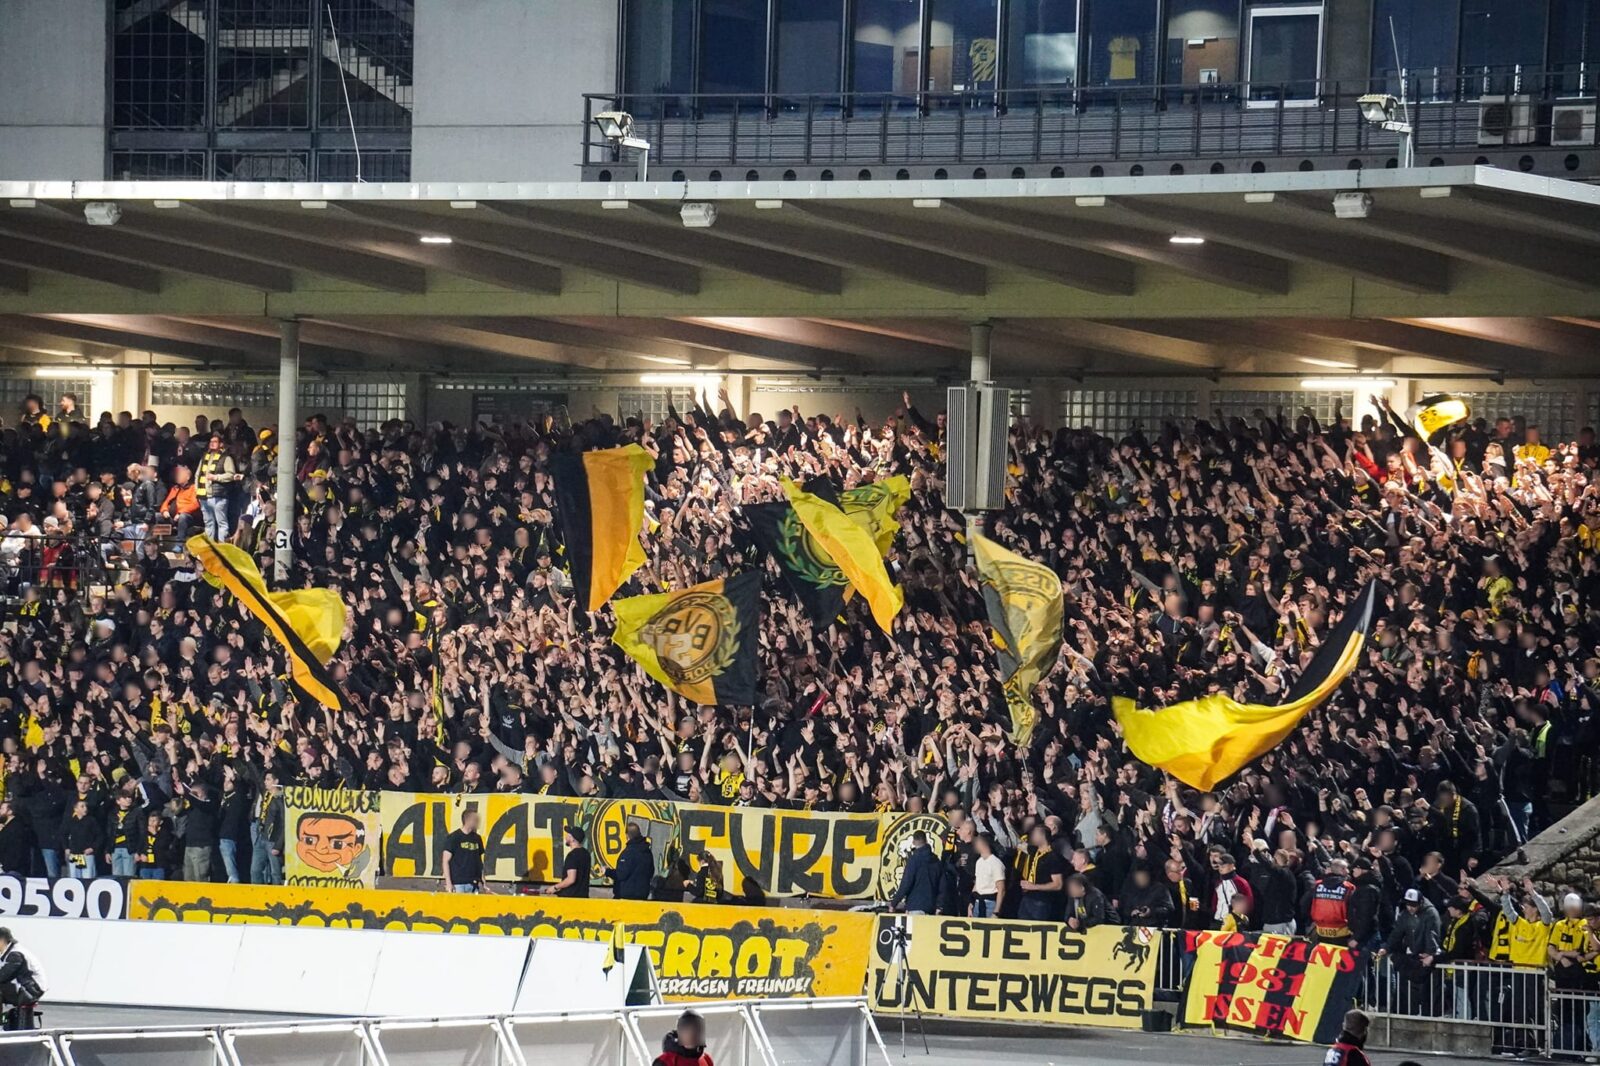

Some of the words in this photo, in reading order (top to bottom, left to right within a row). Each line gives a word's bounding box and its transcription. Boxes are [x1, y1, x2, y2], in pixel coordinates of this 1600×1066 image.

[940, 920, 1087, 960] STETS
[737, 977, 811, 993] FREUNDE!
[875, 968, 1145, 1017] UNTERWEGS
[1215, 961, 1307, 998] 1981
